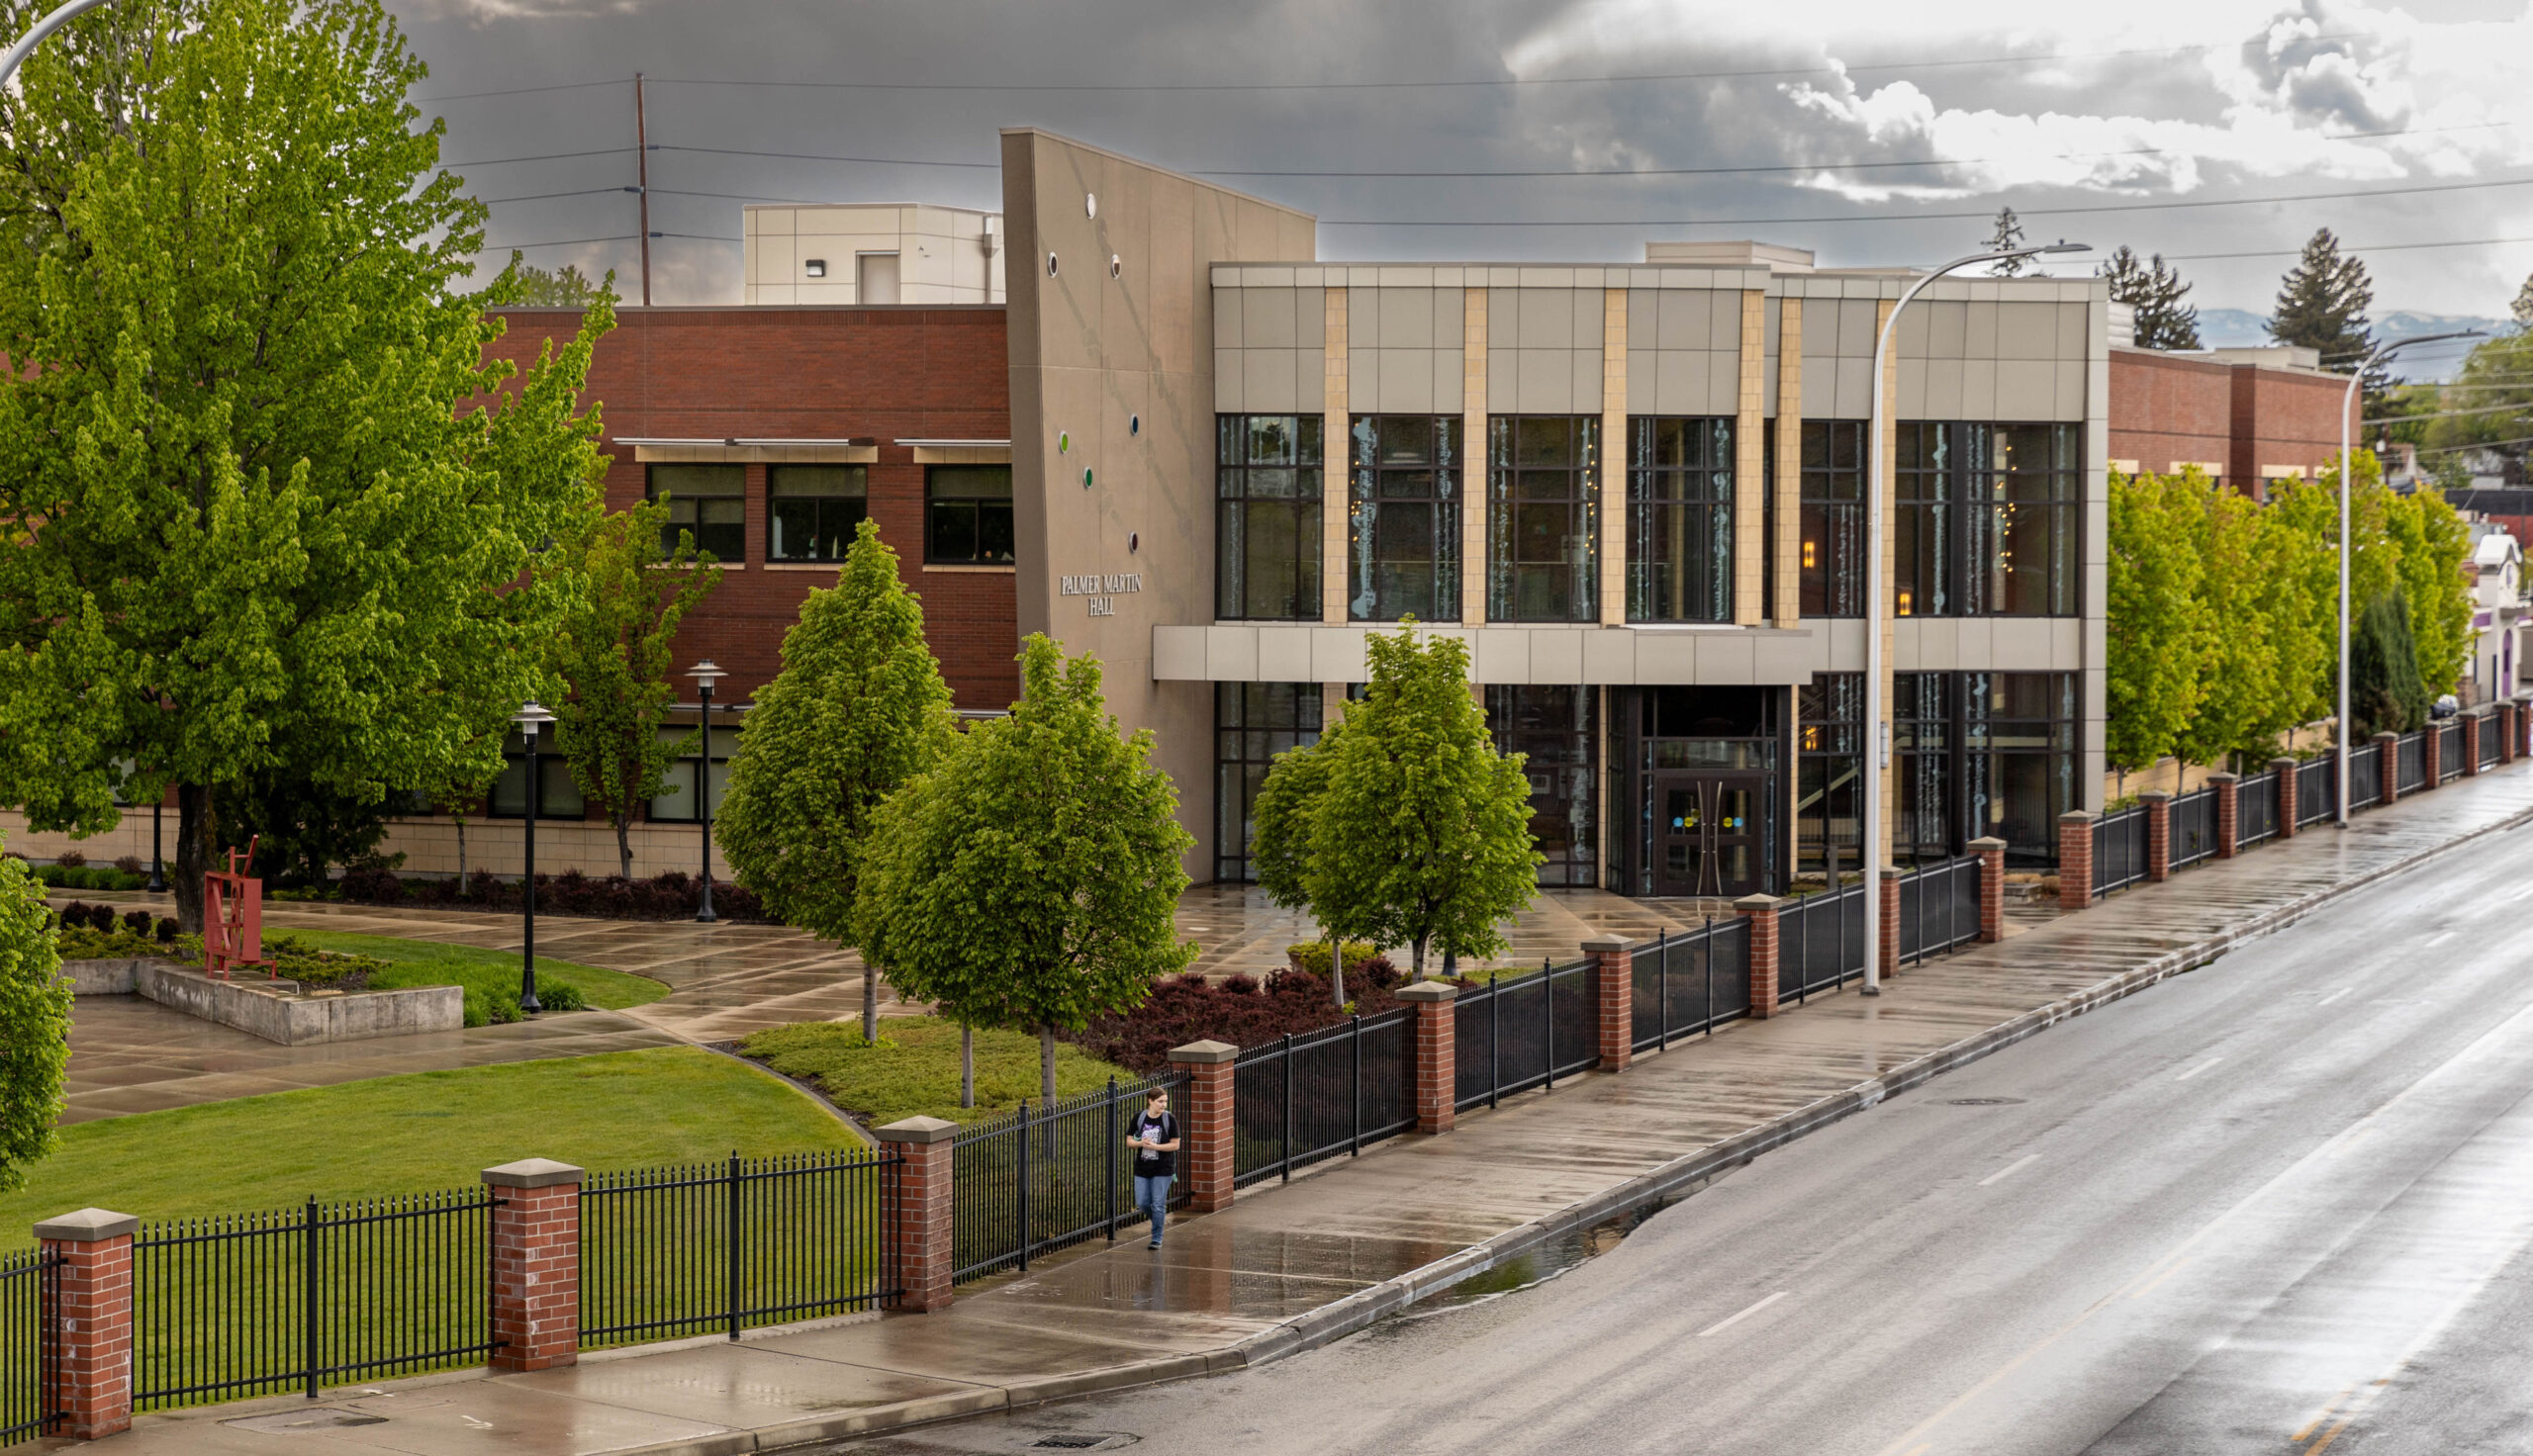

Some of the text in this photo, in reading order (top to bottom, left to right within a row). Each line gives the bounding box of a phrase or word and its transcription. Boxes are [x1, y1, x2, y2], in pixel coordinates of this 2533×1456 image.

[1062, 574, 1142, 595] PALMER MARTIN
[1089, 596, 1115, 616] HALL
